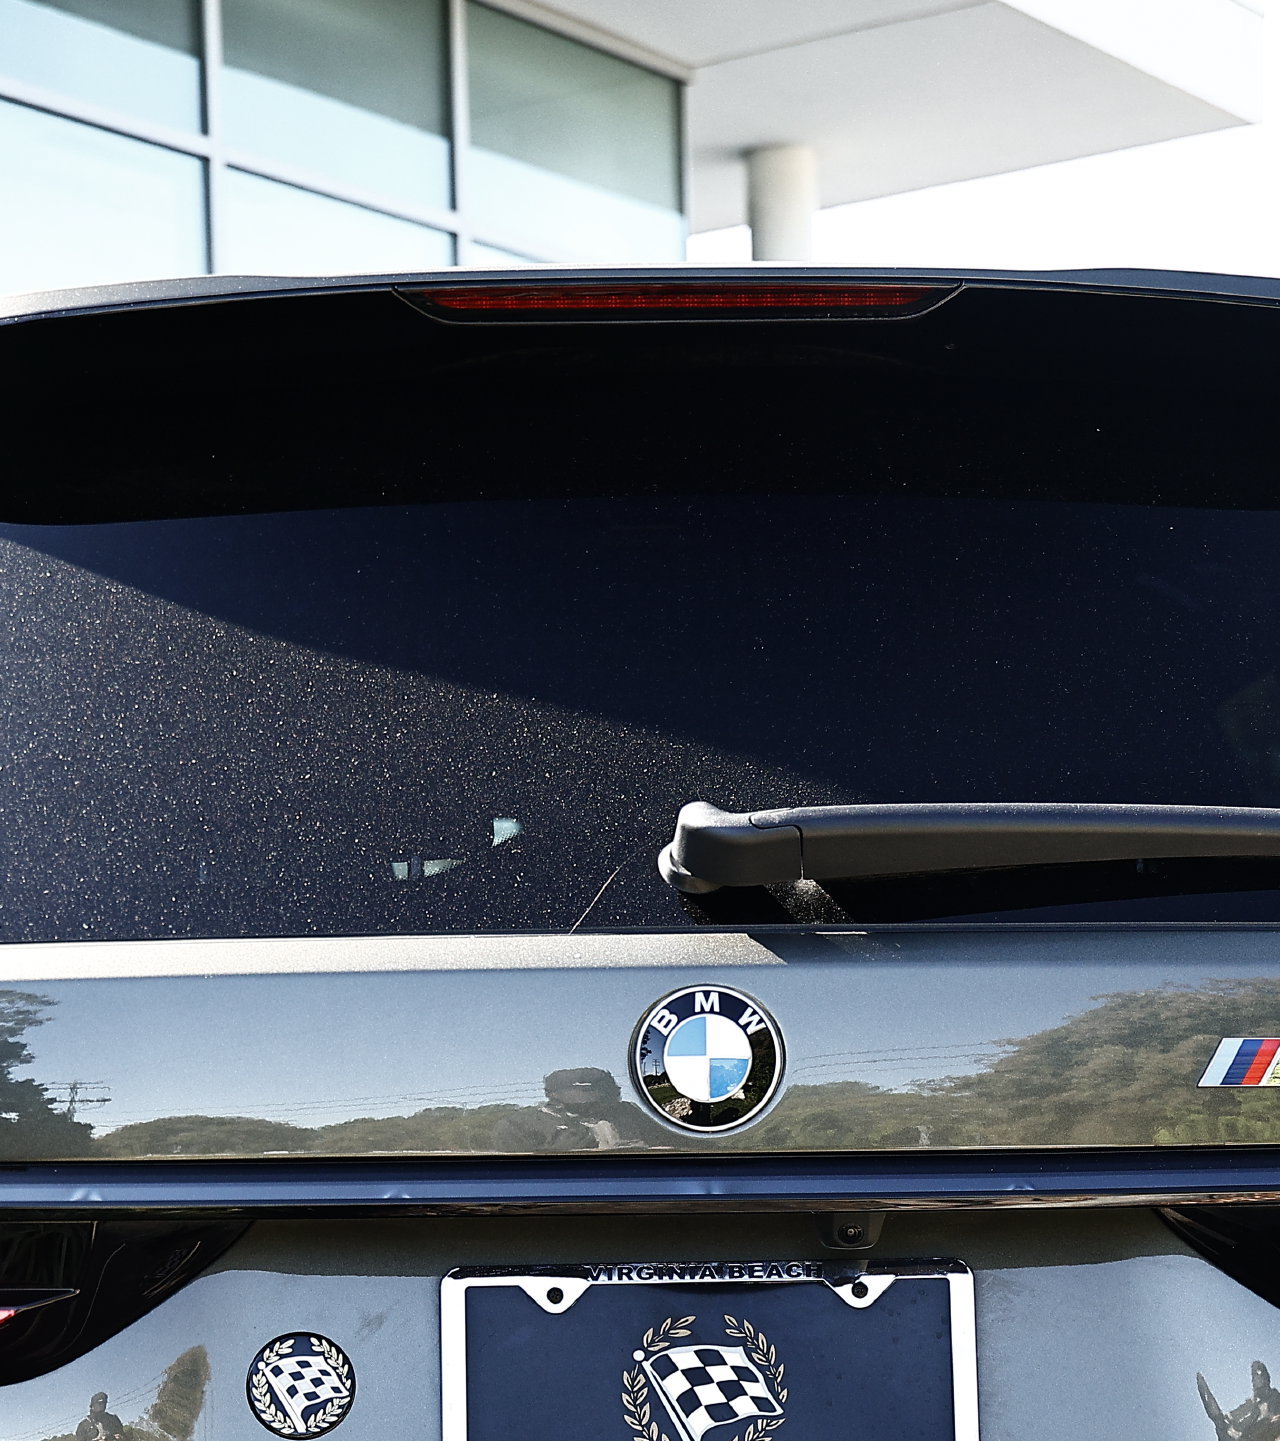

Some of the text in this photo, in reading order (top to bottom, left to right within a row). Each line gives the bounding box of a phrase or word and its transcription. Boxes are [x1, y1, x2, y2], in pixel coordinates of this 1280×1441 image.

[650, 991, 767, 1036] BMW
[587, 1261, 823, 1281] VIRGINIA BEACH
